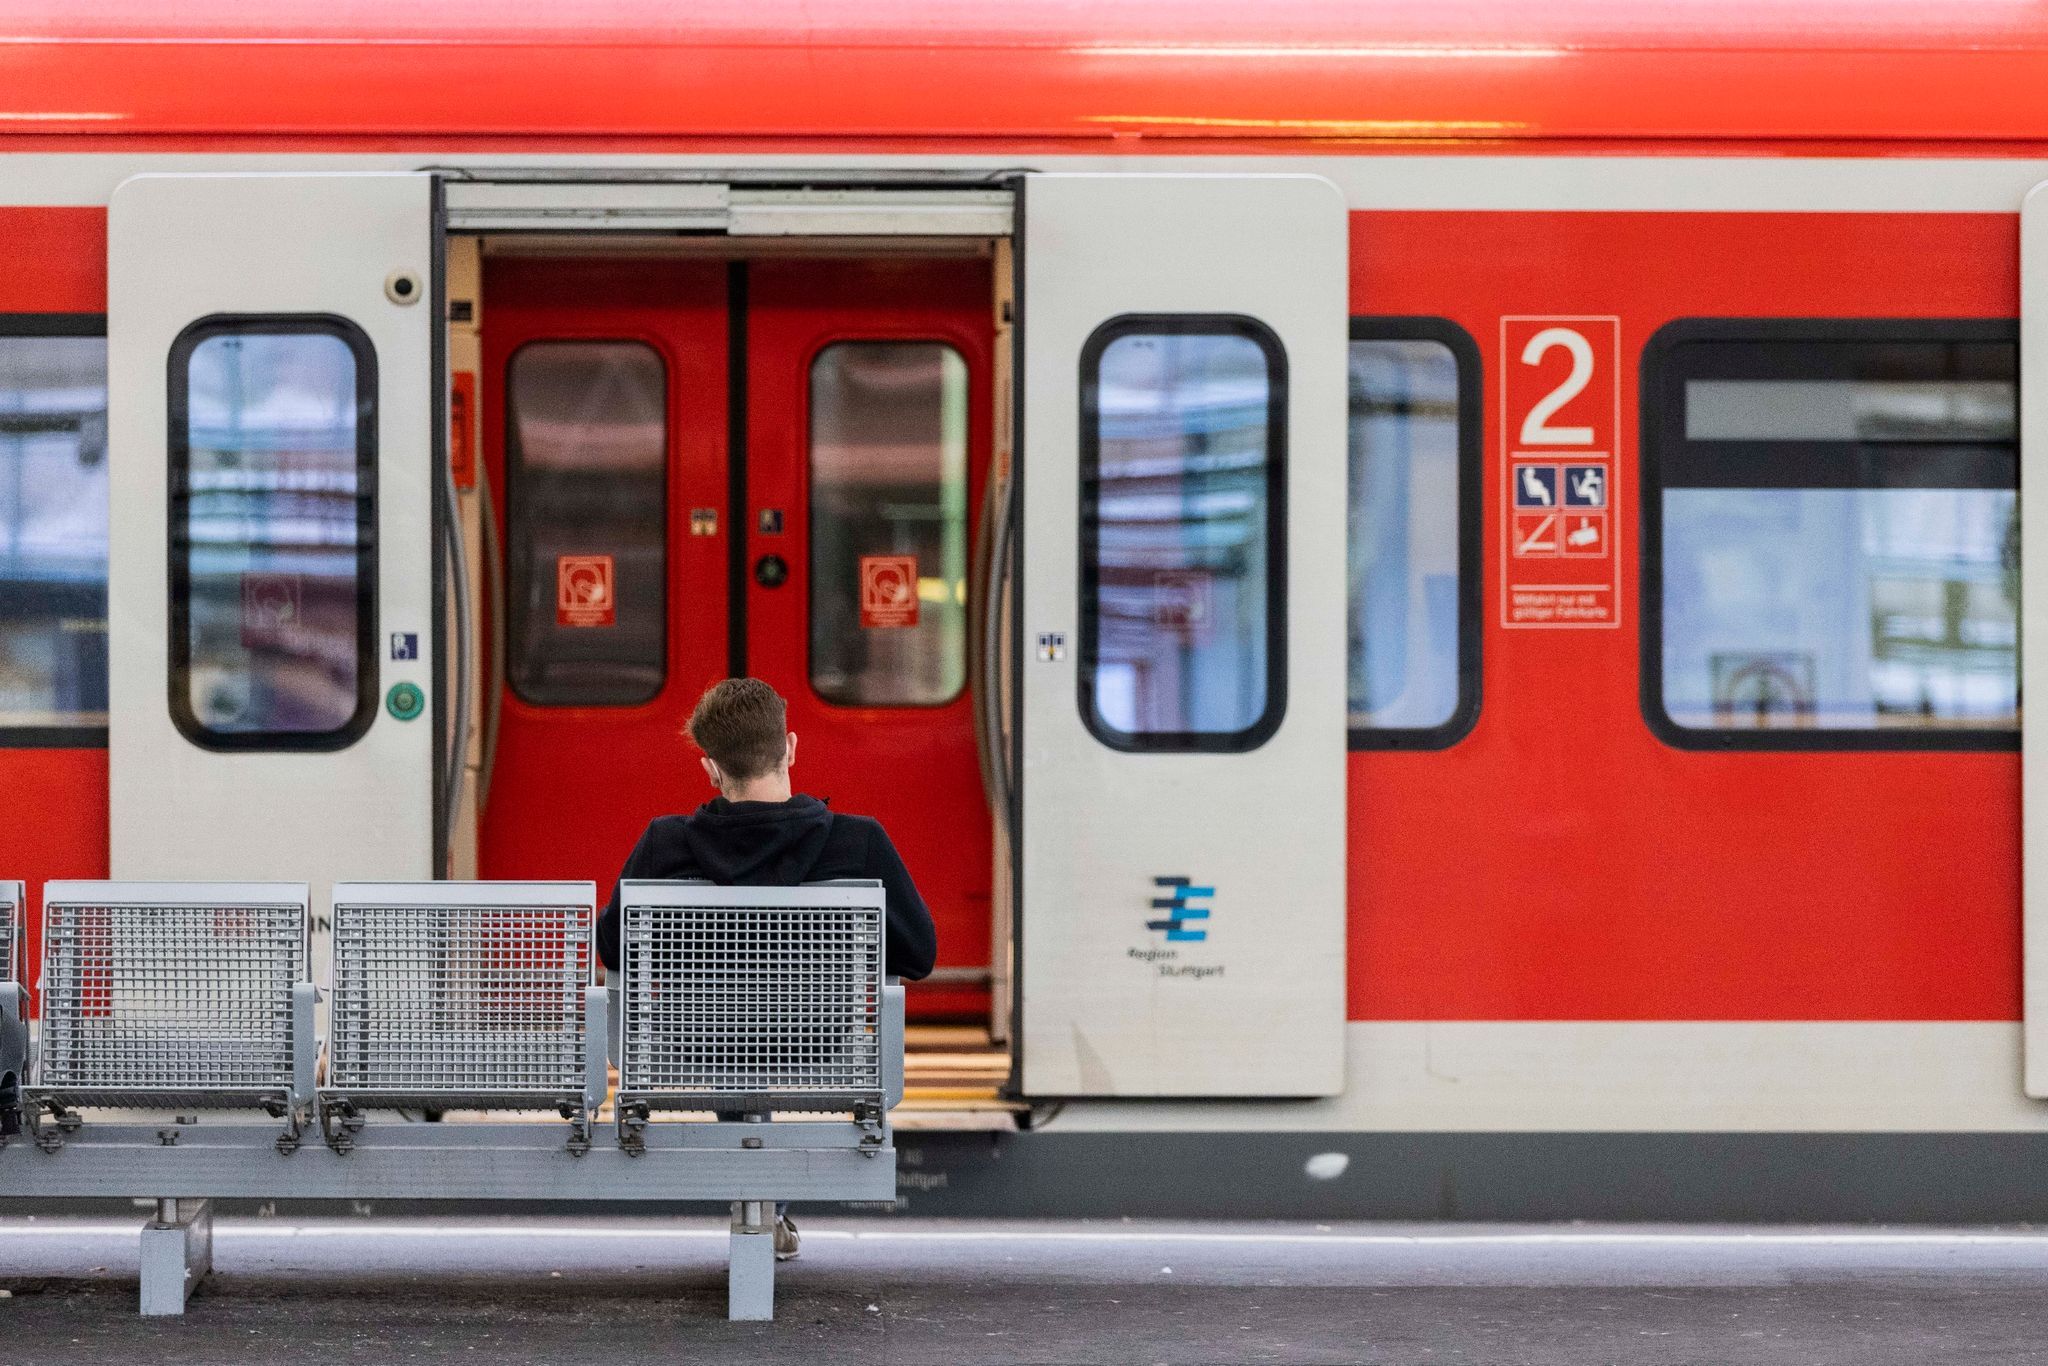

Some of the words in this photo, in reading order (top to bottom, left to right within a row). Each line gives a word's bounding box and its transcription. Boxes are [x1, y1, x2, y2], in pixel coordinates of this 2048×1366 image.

[1520, 327, 1594, 445] 2
[1127, 946, 1177, 961] Region
[1159, 965, 1225, 980] Stuttgart
